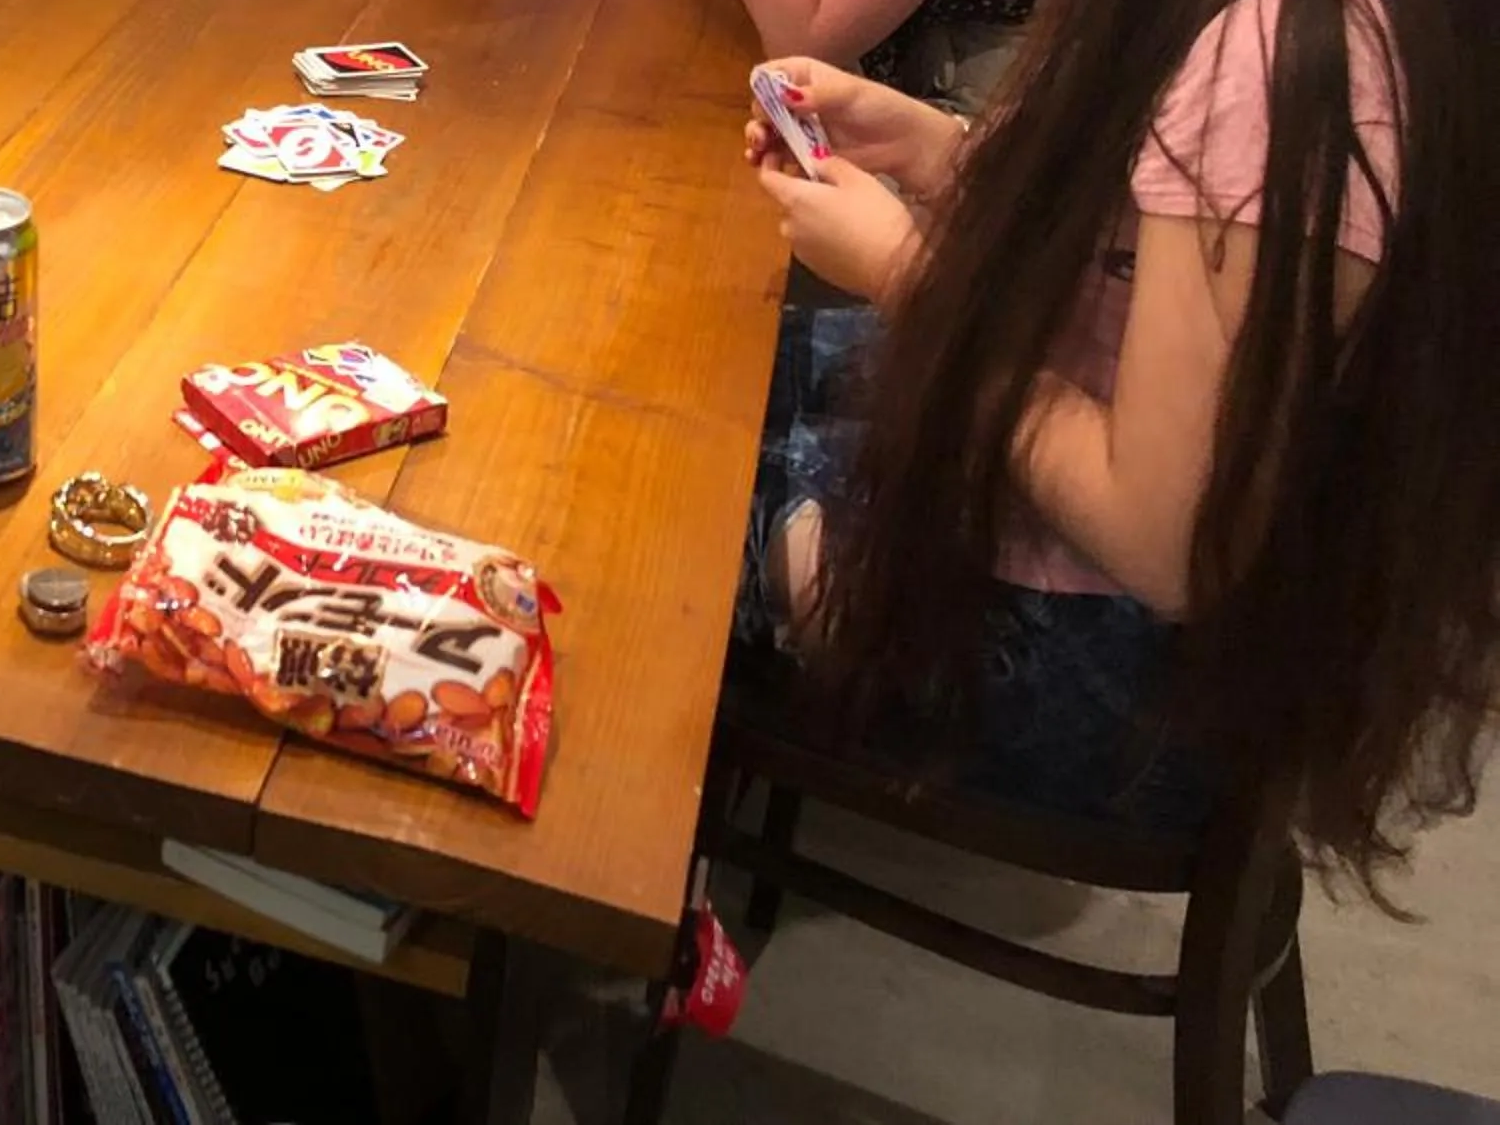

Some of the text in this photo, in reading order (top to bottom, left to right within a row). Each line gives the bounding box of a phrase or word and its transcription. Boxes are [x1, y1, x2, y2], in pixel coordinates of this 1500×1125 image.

[299, 431, 343, 469] UNO
[202, 552, 503, 674] アーモンド
